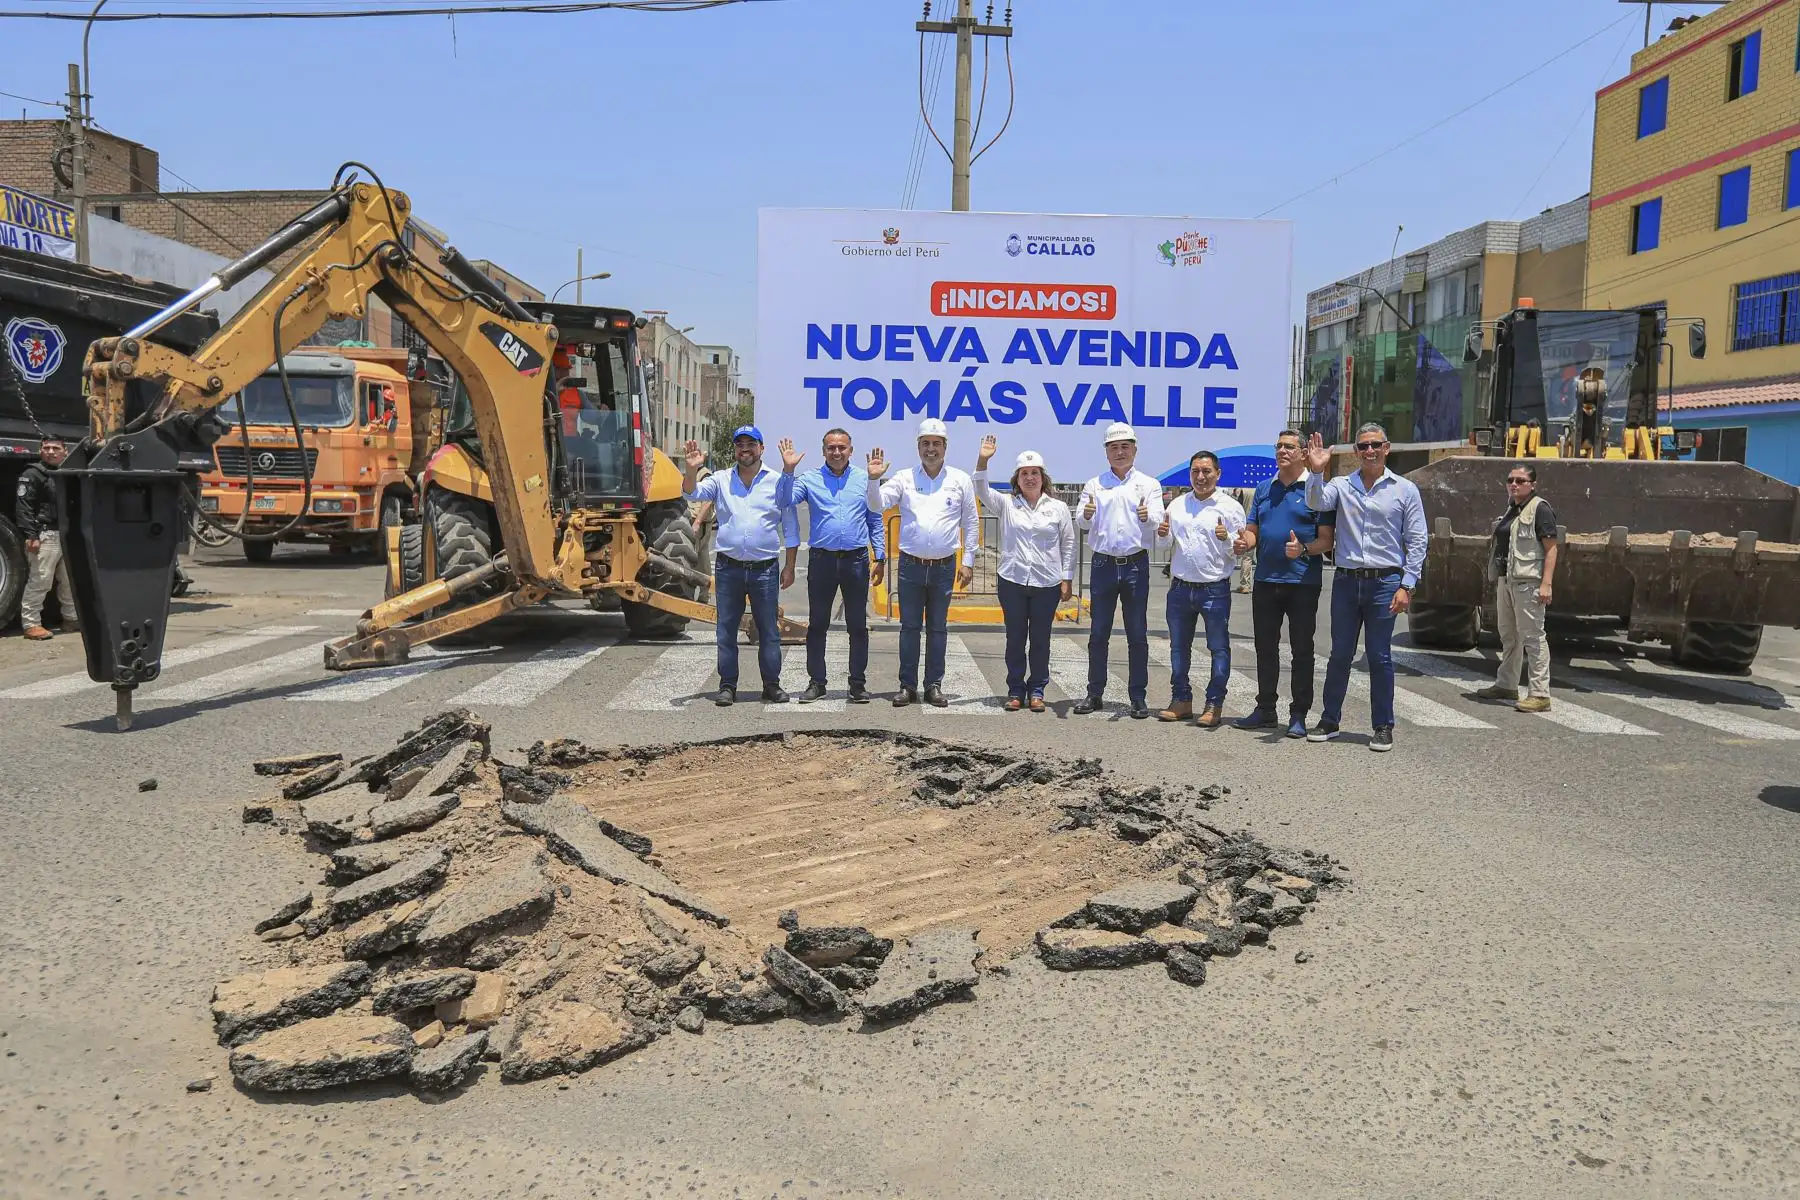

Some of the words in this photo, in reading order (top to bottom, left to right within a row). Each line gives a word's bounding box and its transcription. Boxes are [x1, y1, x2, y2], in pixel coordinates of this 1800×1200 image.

[5, 191, 73, 238] NORTE
[841, 245, 893, 257] Gobierno
[895, 246, 912, 257] del
[915, 247, 940, 258] Perú
[1026, 242, 1096, 256] CALLAO
[941, 288, 1108, 313] ¡INICIAMOS!
[499, 331, 529, 368] CAT
[806, 323, 989, 363] NUEVA
[1002, 327, 1239, 370] AVENIDA
[804, 366, 1028, 425] TOMÁS
[1043, 382, 1239, 430] VALLE
